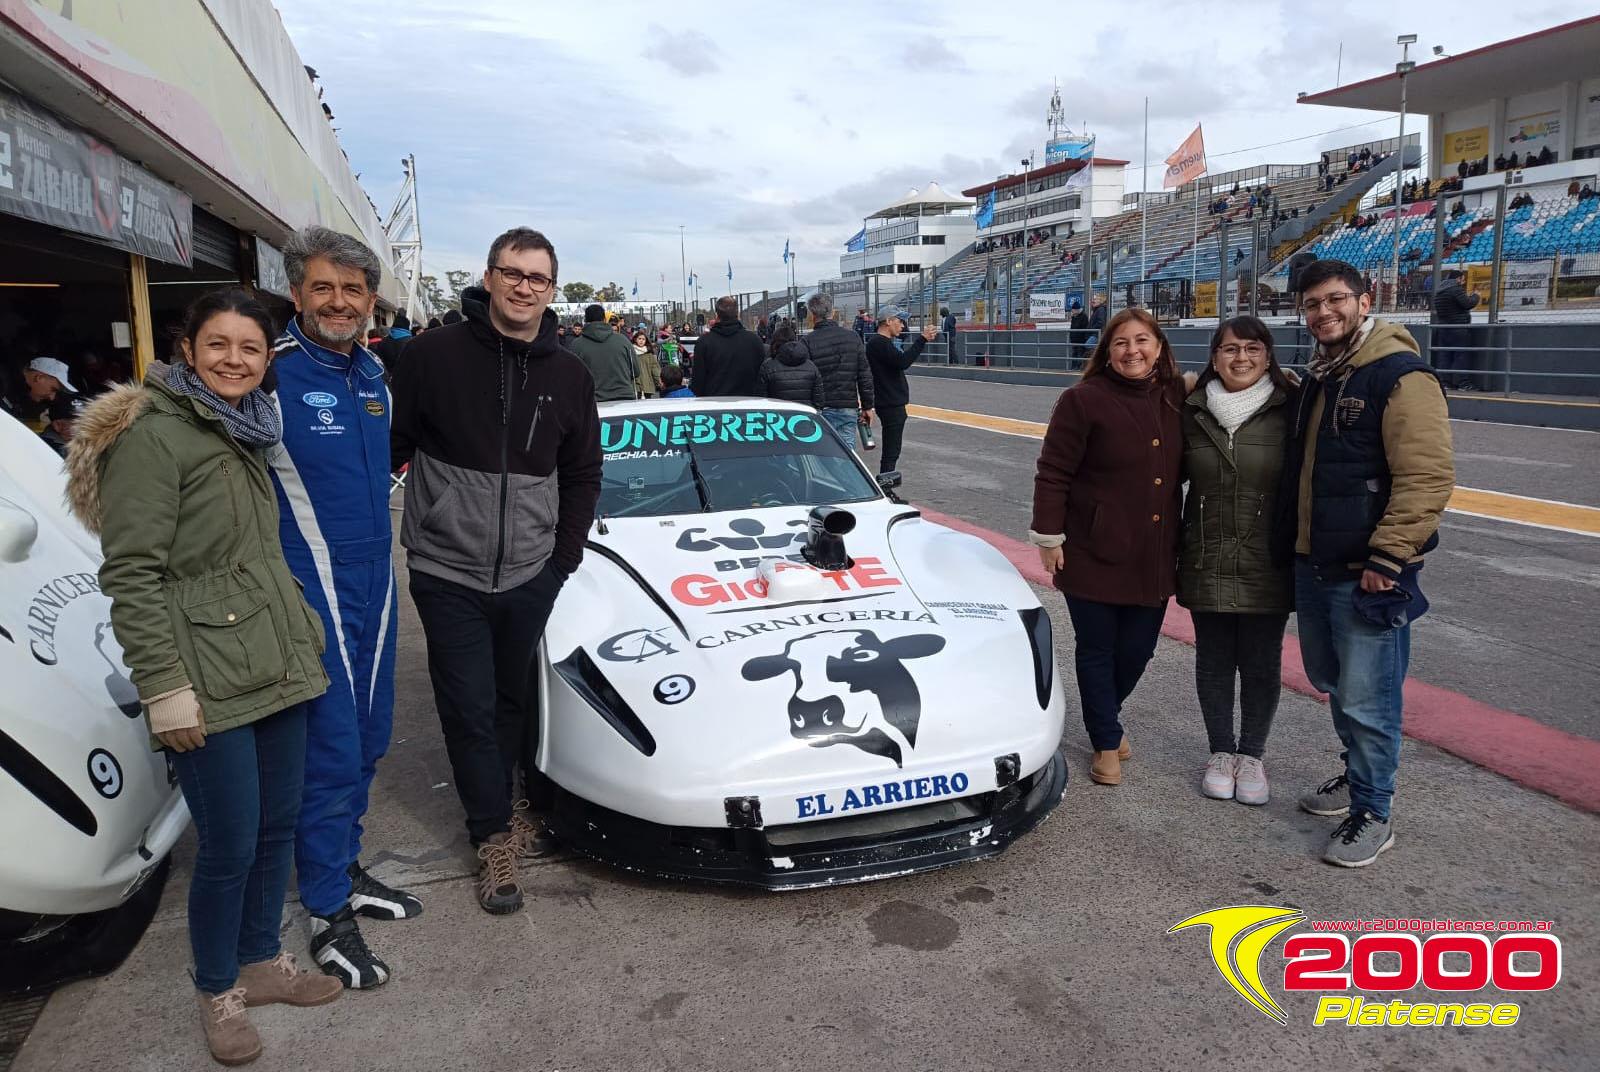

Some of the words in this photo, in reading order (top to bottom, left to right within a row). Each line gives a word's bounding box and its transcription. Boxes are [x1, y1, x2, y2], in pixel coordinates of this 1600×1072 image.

[20, 153, 97, 217] ZABALA
[120, 186, 136, 229] 9
[27, 573, 102, 666] CARNICER
[695, 608, 941, 650] CARNICERIA
[658, 676, 691, 703] 9
[90, 752, 121, 796] 9
[795, 794, 834, 819] EL
[840, 771, 970, 812] ARRIERO
